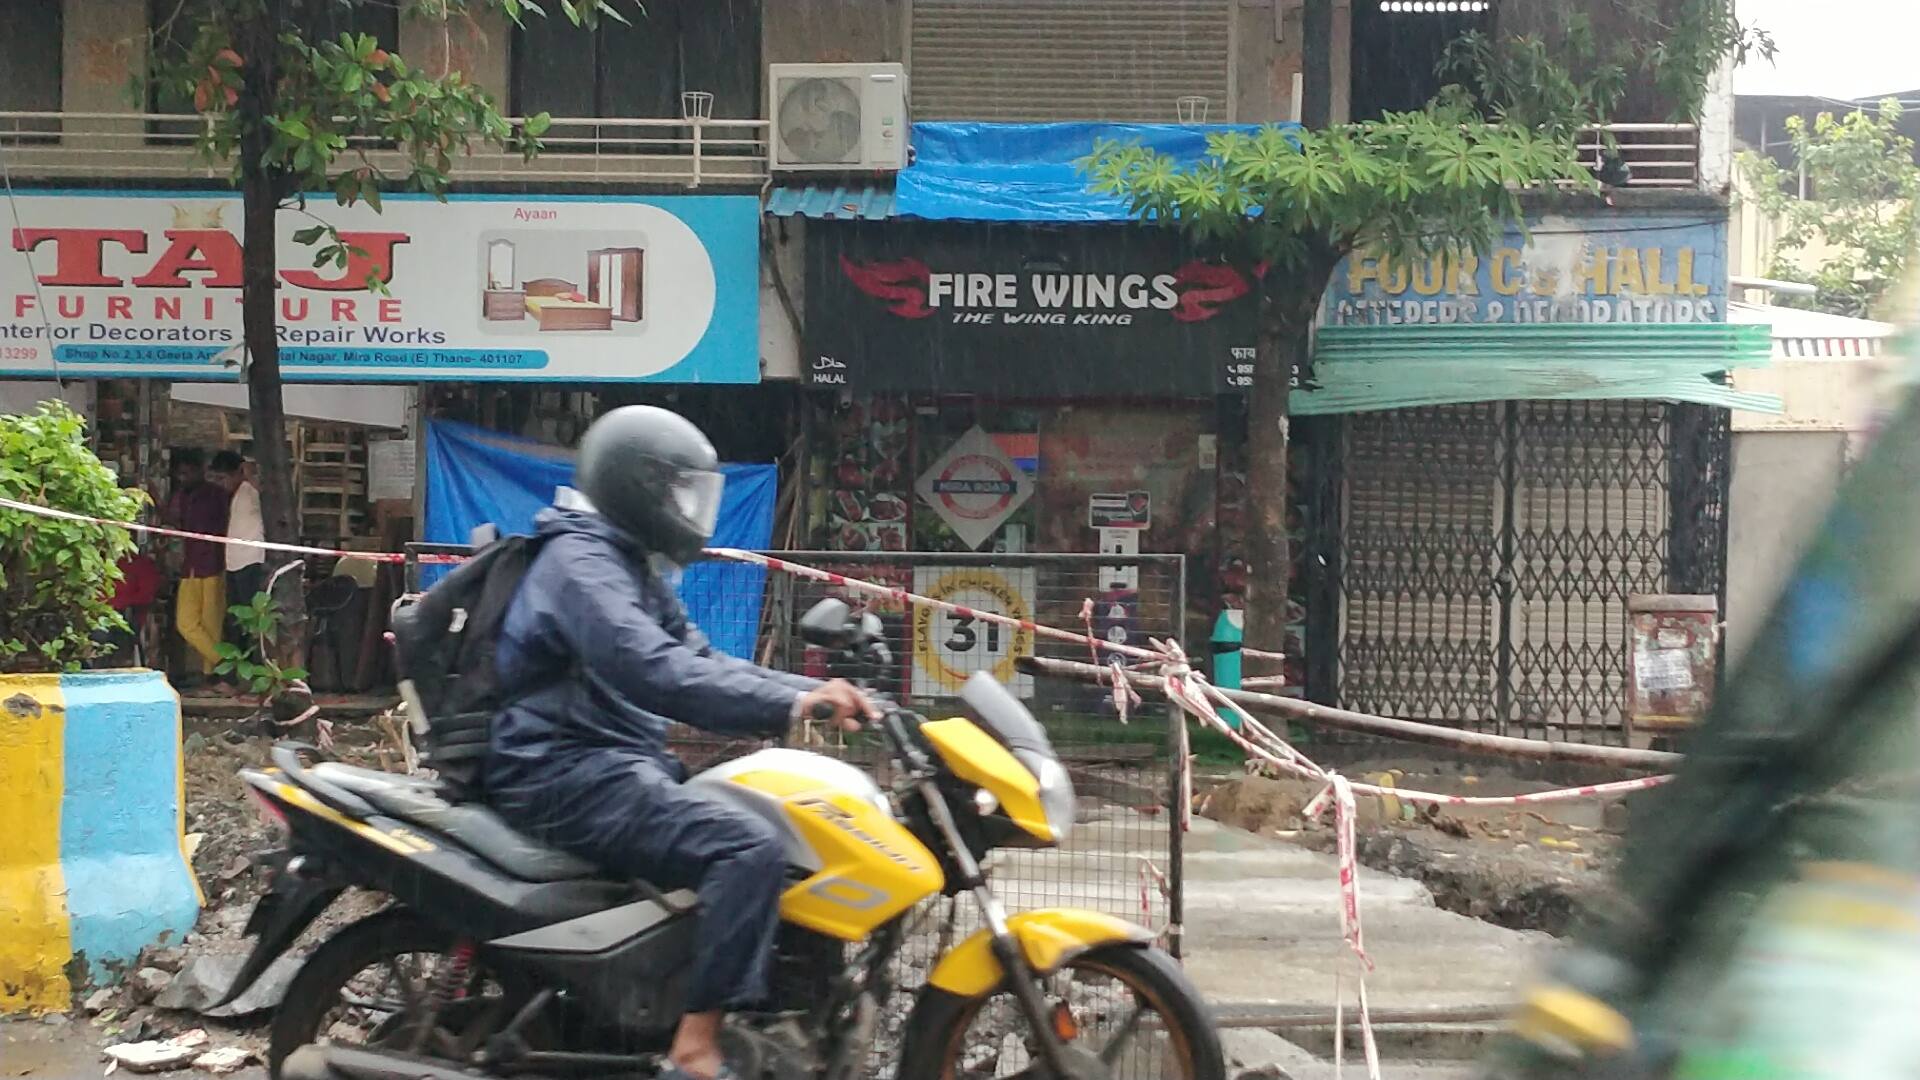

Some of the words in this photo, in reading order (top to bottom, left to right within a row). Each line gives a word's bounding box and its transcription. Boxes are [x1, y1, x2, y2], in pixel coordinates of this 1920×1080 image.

[514, 207, 557, 220] Ayaan
[12, 228, 411, 292] TAJ
[1349, 247, 1479, 296] FOUR
[1579, 247, 1709, 296] HALL
[928, 273, 1017, 308] FIRE
[1031, 273, 1178, 310] WINGS
[15, 295, 402, 323] FURNIURE
[952, 312, 992, 325] THE
[1003, 312, 1065, 326] WING
[1073, 313, 1133, 326] KING
[0, 324, 80, 341] nterior
[90, 323, 232, 343] Decorators
[276, 325, 355, 345] Repair
[364, 326, 446, 345] Works
[0, 347, 38, 360] 3299
[65, 349, 97, 360] Shop
[157, 350, 193, 361] Geeta
[344, 353, 371, 363] Mira
[376, 353, 407, 364] Road
[411, 352, 429, 366] (E)
[480, 354, 523, 365] 401107
[813, 374, 847, 385] HALAL
[944, 610, 1000, 652] 31
